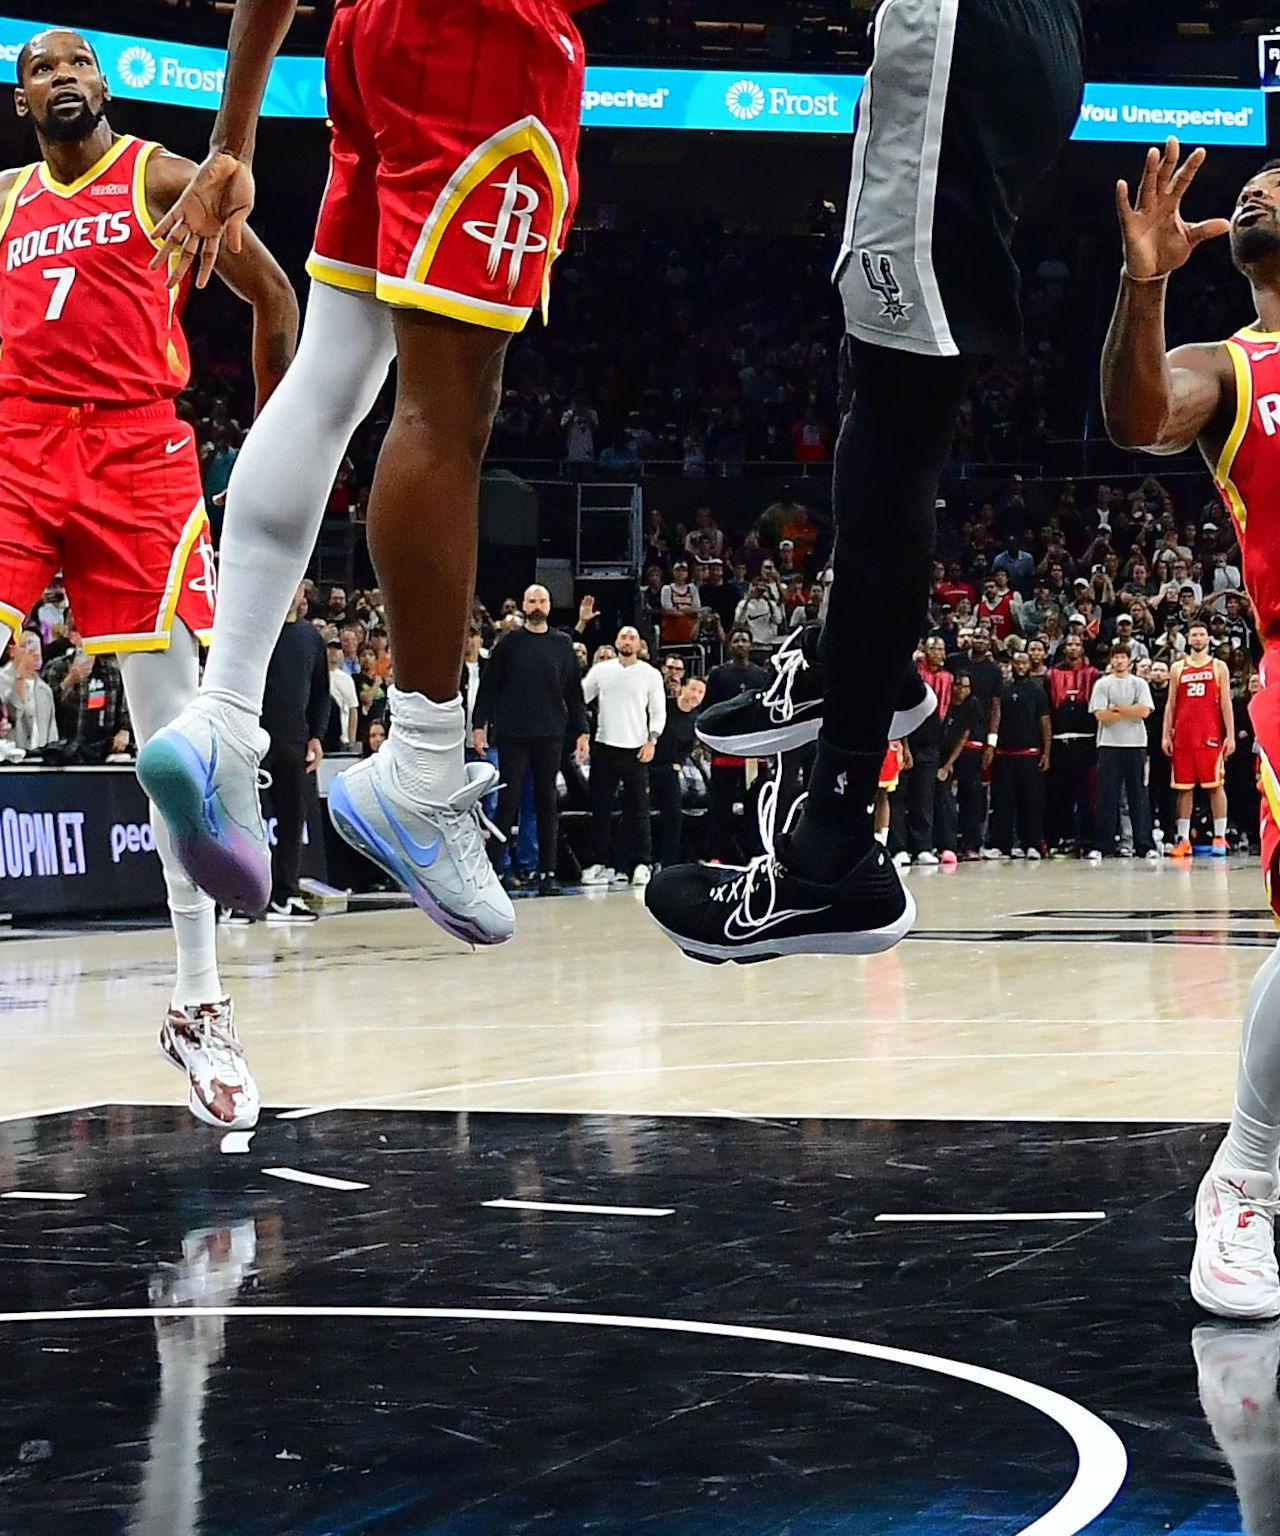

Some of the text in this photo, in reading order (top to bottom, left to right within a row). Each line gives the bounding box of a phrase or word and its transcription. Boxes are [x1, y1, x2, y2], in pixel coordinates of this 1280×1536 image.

[161, 57, 225, 94] Frost
[581, 87, 664, 111] pected
[770, 87, 839, 116] Frost
[1081, 104, 1118, 123] You
[6, 210, 131, 272] ROCKETS
[42, 267, 76, 321] 7
[1186, 683, 1206, 697] 28
[58, 809, 87, 876] ET
